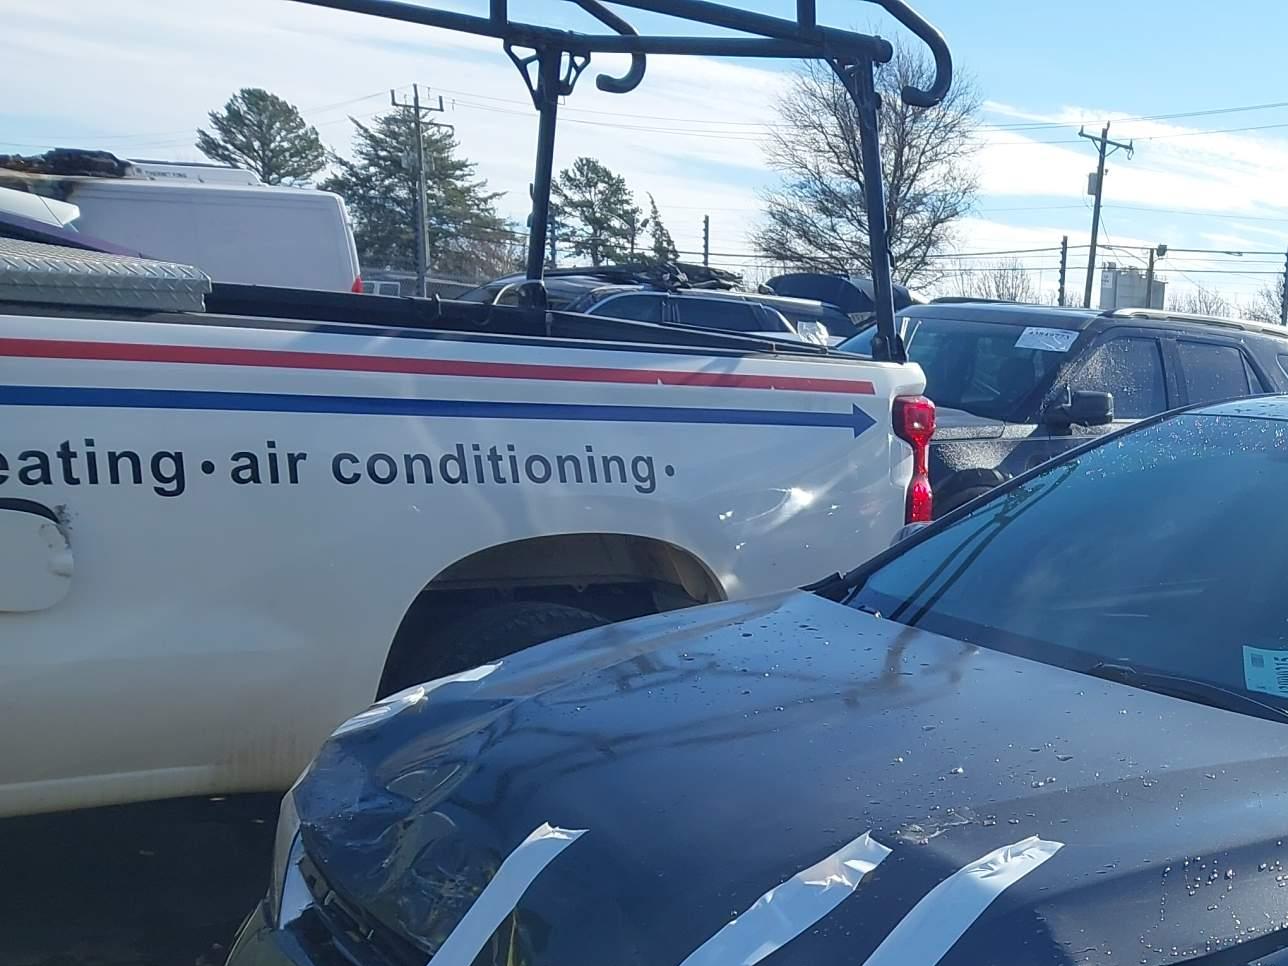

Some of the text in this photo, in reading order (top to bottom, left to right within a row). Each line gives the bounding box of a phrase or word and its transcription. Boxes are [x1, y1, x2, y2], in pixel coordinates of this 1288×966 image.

[0, 438, 657, 497] ating air conditioning
